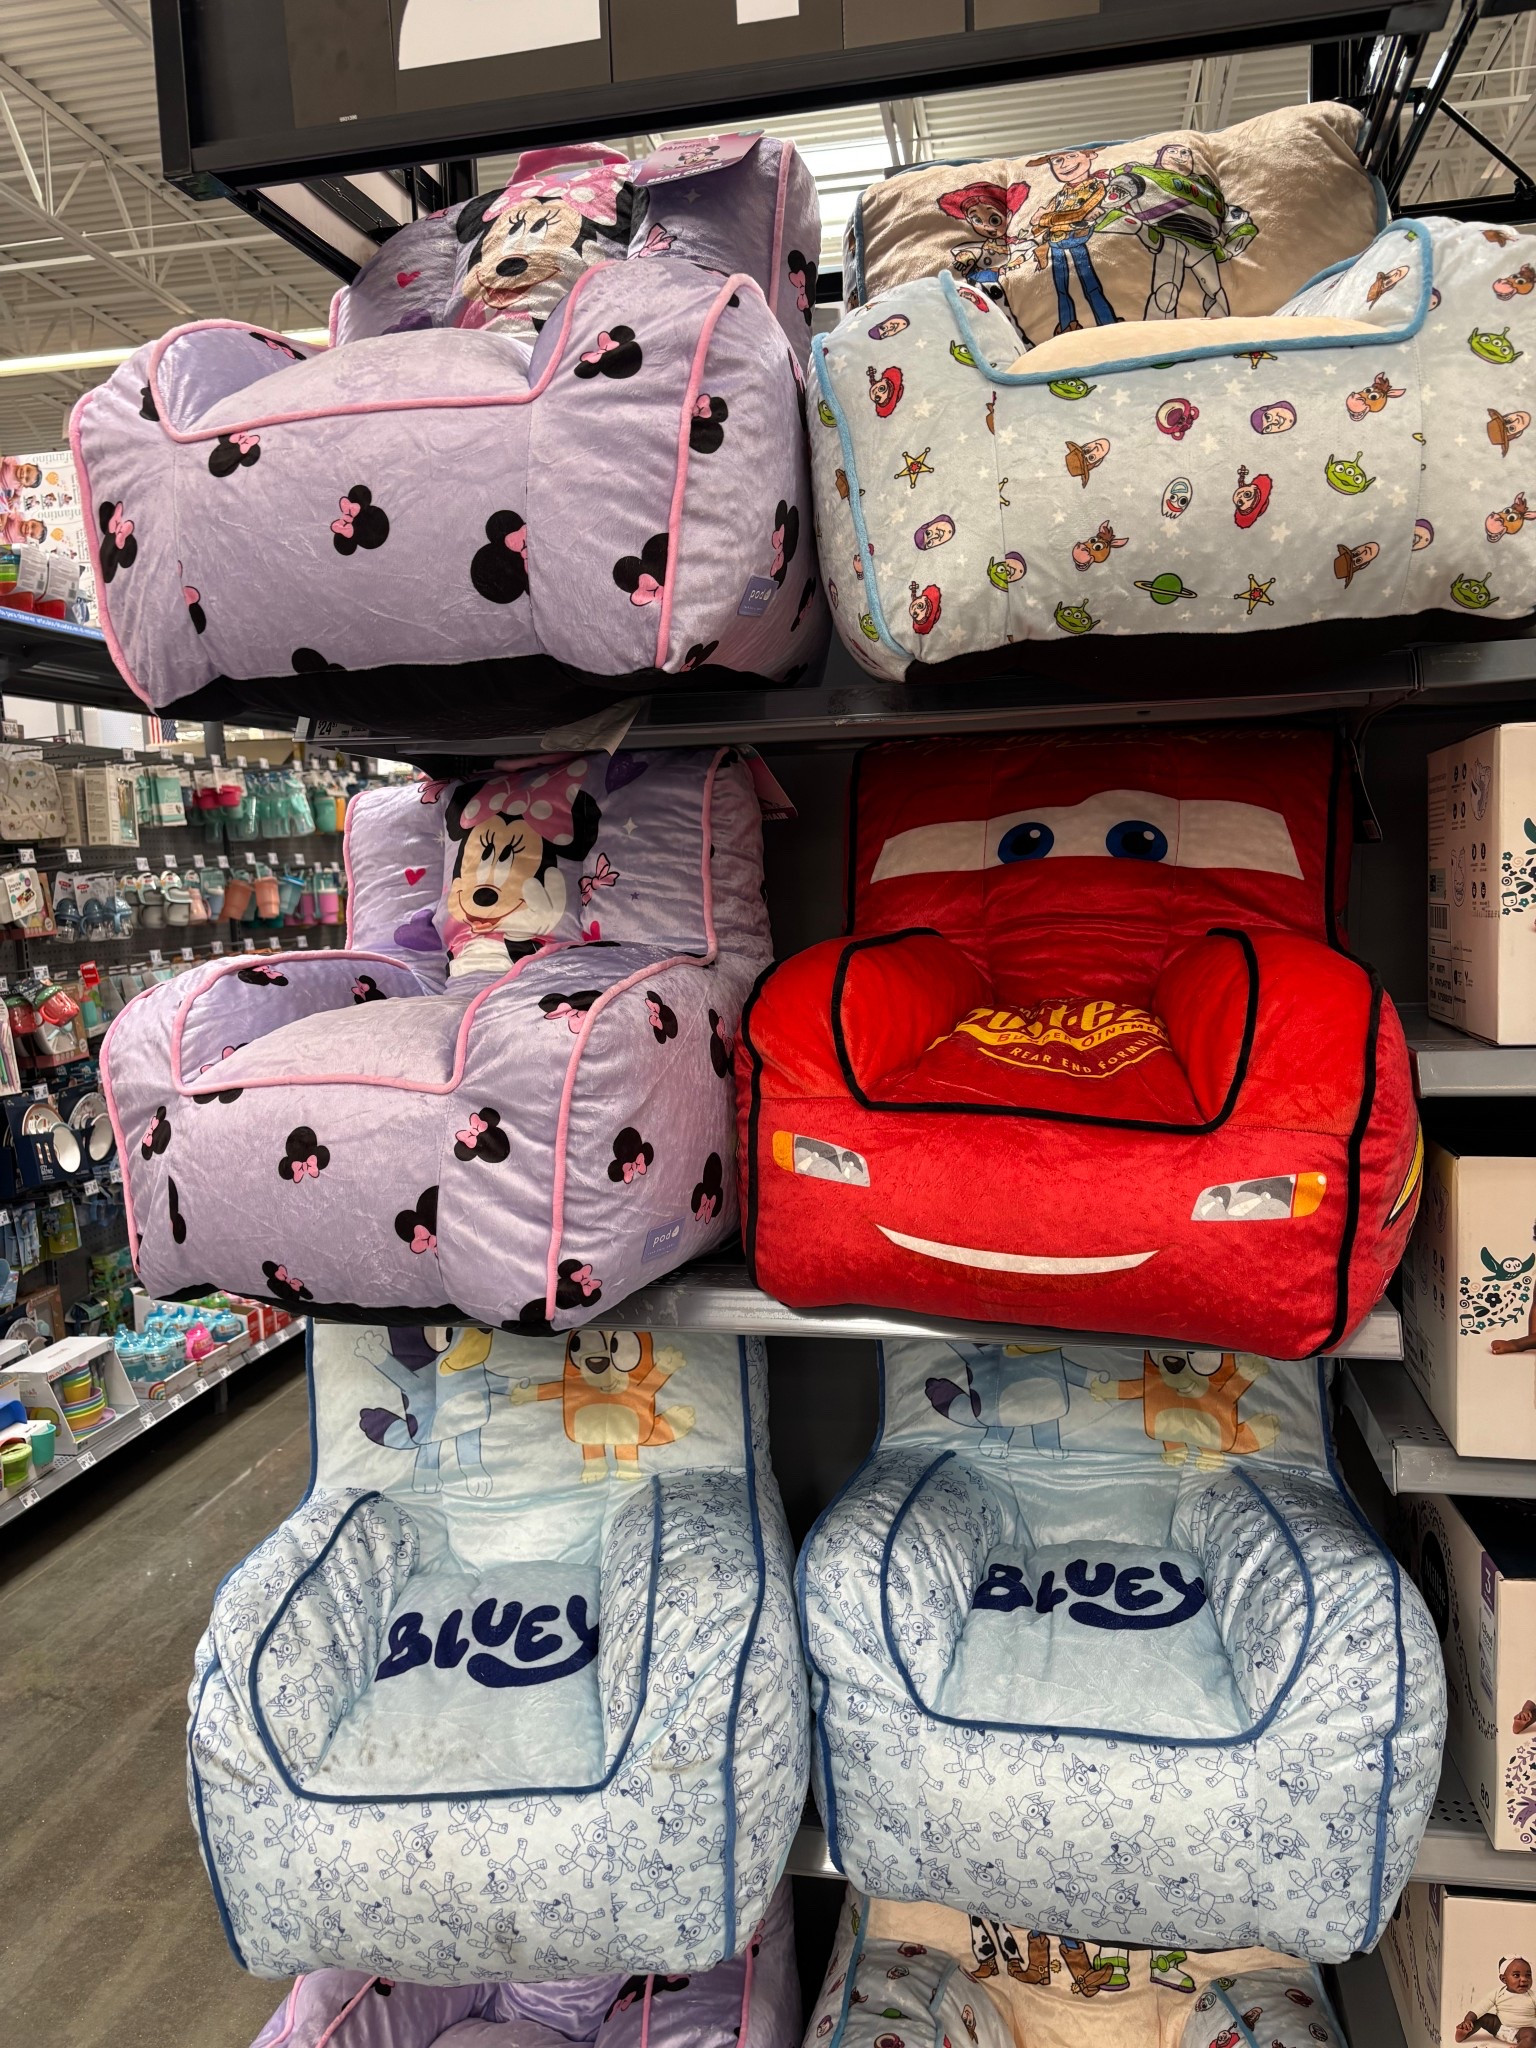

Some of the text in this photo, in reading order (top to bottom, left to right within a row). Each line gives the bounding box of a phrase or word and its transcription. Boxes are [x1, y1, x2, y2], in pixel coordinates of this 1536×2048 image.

[647, 163, 723, 184] BEAN CHAIR
[33, 452, 74, 464] fantino
[37, 508, 81, 521] nfantino
[1009, 1047, 1051, 1063] REAR
[1062, 1057, 1092, 1074] END
[652, 1228, 672, 1248] pod
[1484, 1567, 1491, 1595] 3
[972, 1558, 1207, 1631] BLUEY
[374, 1594, 600, 1689] BLUEY
